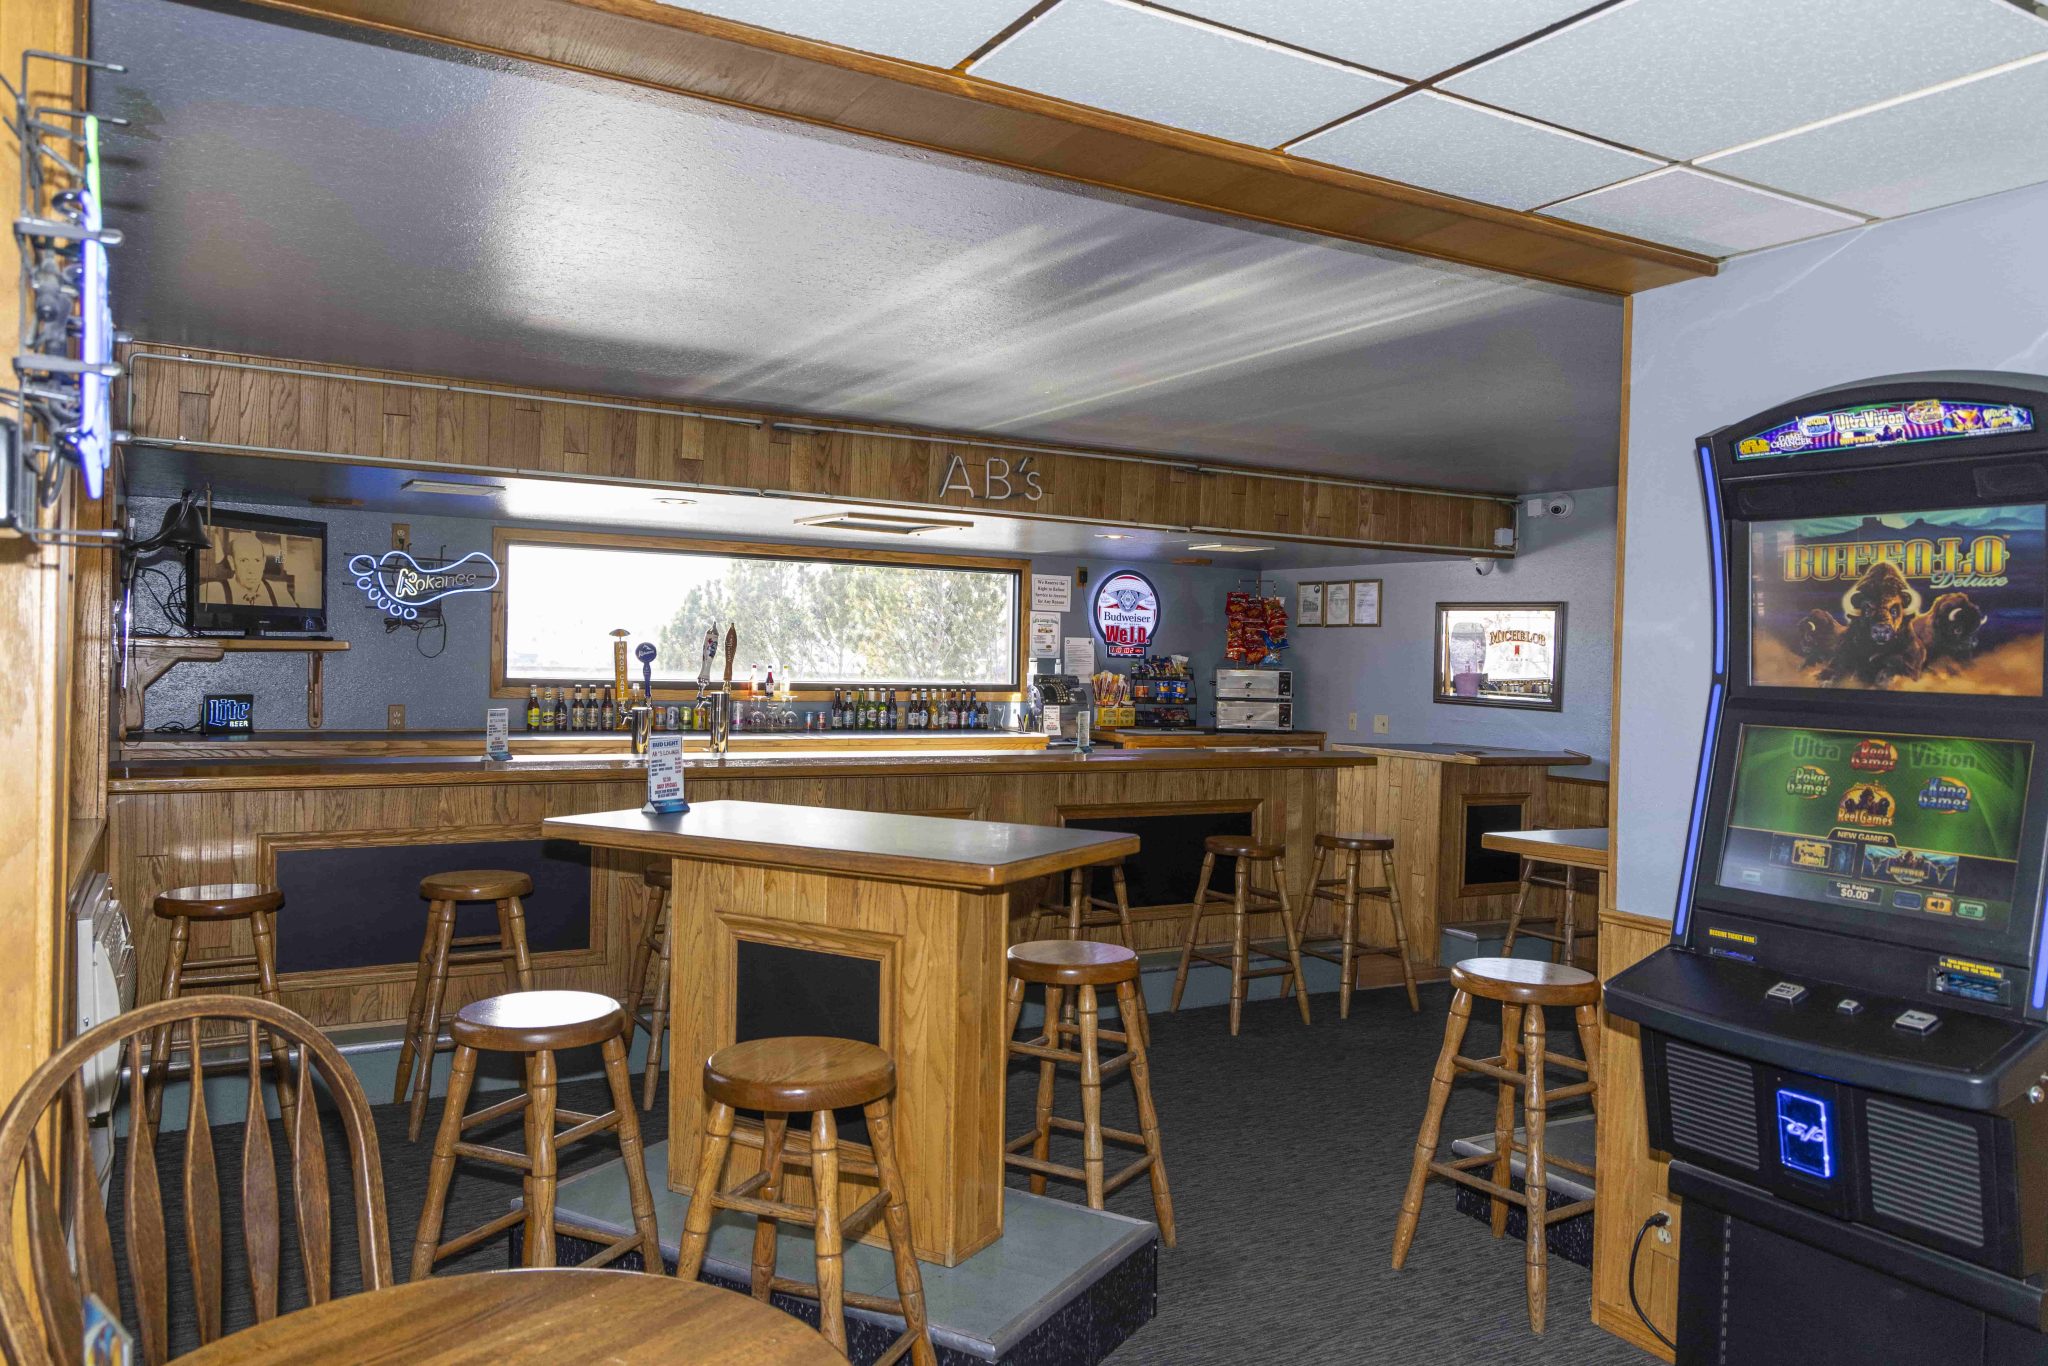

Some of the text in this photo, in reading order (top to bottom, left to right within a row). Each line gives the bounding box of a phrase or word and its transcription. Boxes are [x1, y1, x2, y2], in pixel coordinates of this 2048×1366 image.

[1834, 410, 1904, 431] UltraVision
[1770, 437, 1814, 449] CHANGER
[939, 455, 1043, 501] AB's
[1784, 536, 2010, 582] BUFFALO
[395, 568, 477, 598] Kokanee
[1929, 571, 2009, 589] Deluxe
[1103, 611, 1151, 623] Budweiser
[1105, 624, 1150, 644] We I.D.
[1488, 629, 1547, 647] MICHELOB
[208, 699, 250, 727] Lite
[229, 720, 249, 728] BEER
[1793, 735, 1840, 760] Ultra
[1860, 740, 1891, 757] Reel
[1910, 742, 1978, 769] Vision
[1795, 767, 1831, 784] Poker
[1786, 779, 1829, 796] Games
[1929, 777, 1967, 795] Keno
[1918, 790, 1969, 810] Games
[1837, 809, 1894, 826] Reel Games
[1837, 830, 1889, 844] NEW GAMES
[1840, 888, 1869, 900] $0.00
[1852, 884, 1875, 893] Balance
[1727, 932, 1743, 941] TICKET
